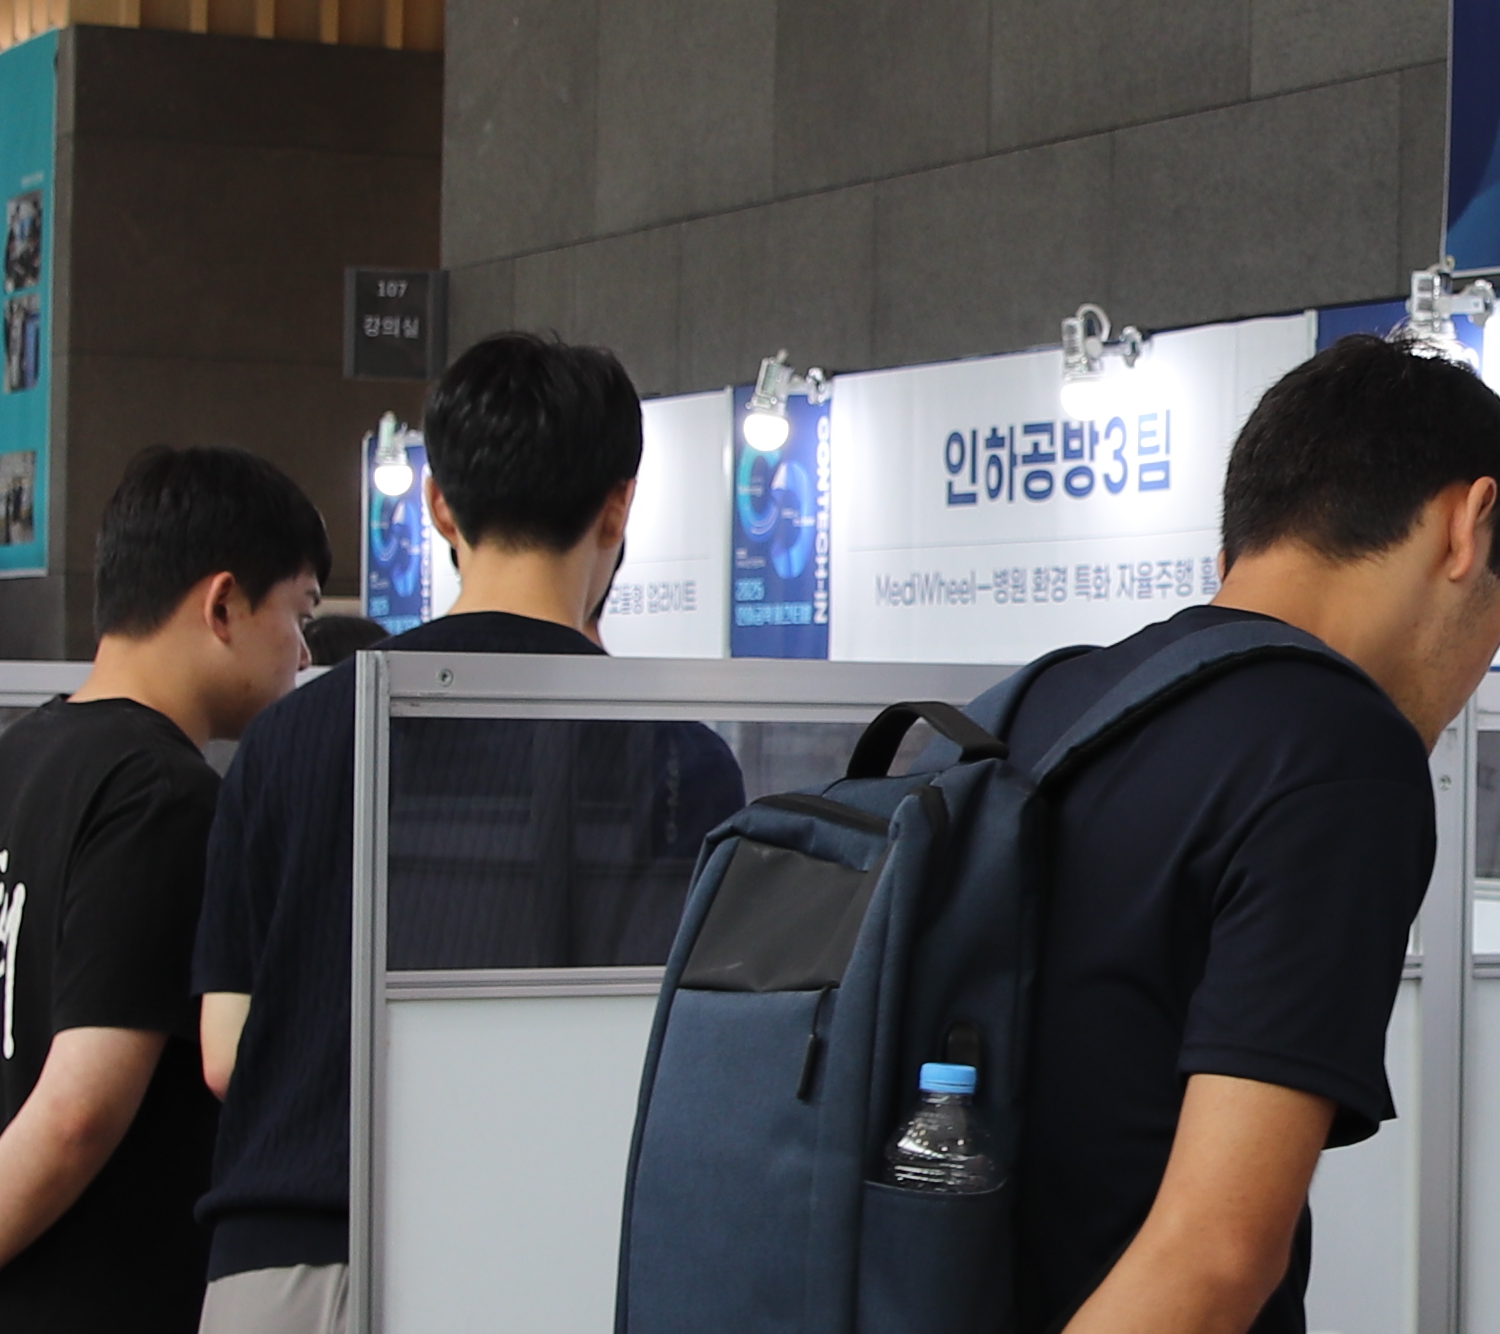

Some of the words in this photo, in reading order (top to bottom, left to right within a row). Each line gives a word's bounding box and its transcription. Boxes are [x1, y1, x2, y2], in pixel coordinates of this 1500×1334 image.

[362, 315, 420, 339] 강의실
[944, 408, 1172, 509] 인하공방3팀
[1115, 556, 1196, 602] 자율주행
